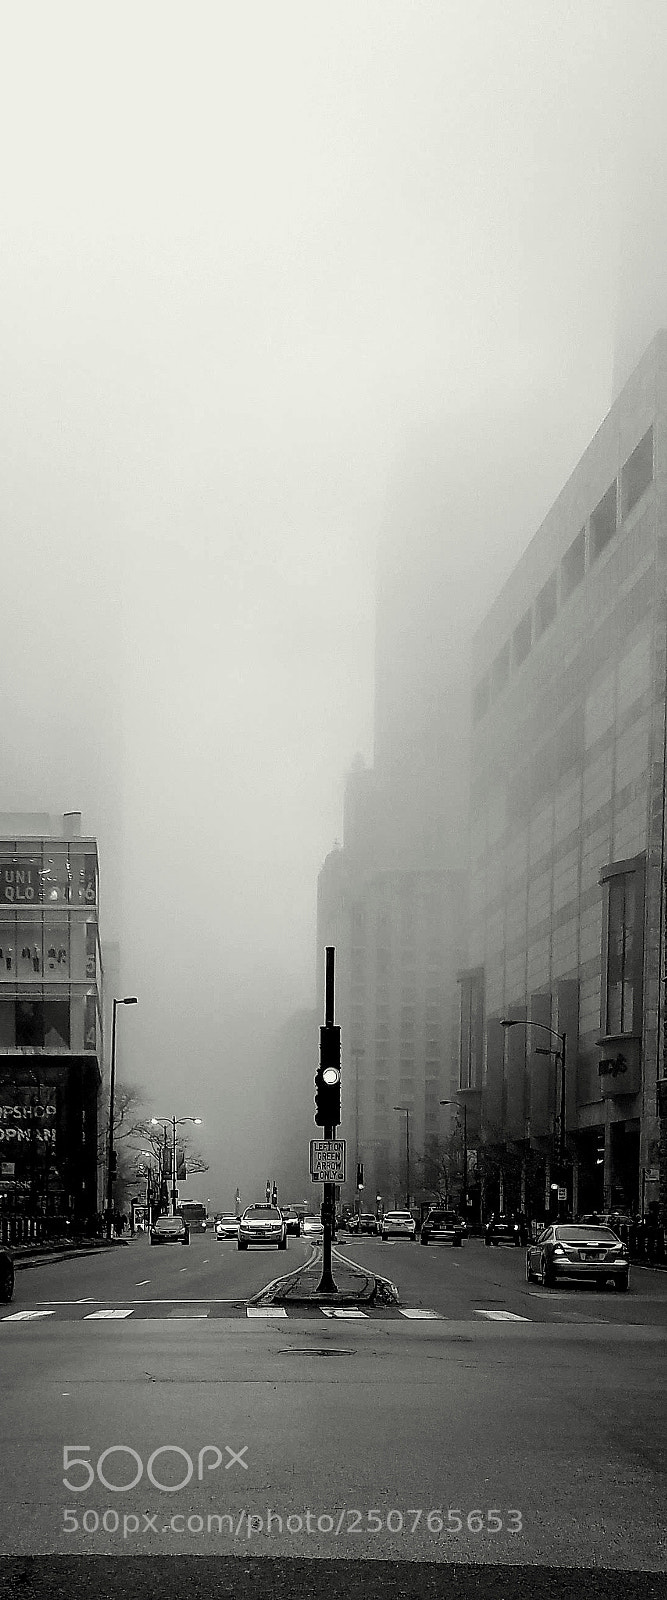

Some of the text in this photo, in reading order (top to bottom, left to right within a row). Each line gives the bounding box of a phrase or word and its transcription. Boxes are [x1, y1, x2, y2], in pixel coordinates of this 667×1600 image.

[5, 870, 32, 883] UNI
[5, 887, 34, 902] QLO
[0, 1105, 57, 1118] PSHOP
[314, 1142, 344, 1151] LEFT ON
[317, 1152, 341, 1161] GREEN
[316, 1161, 341, 1170] ARROW
[320, 1171, 337, 1180] ONLY
